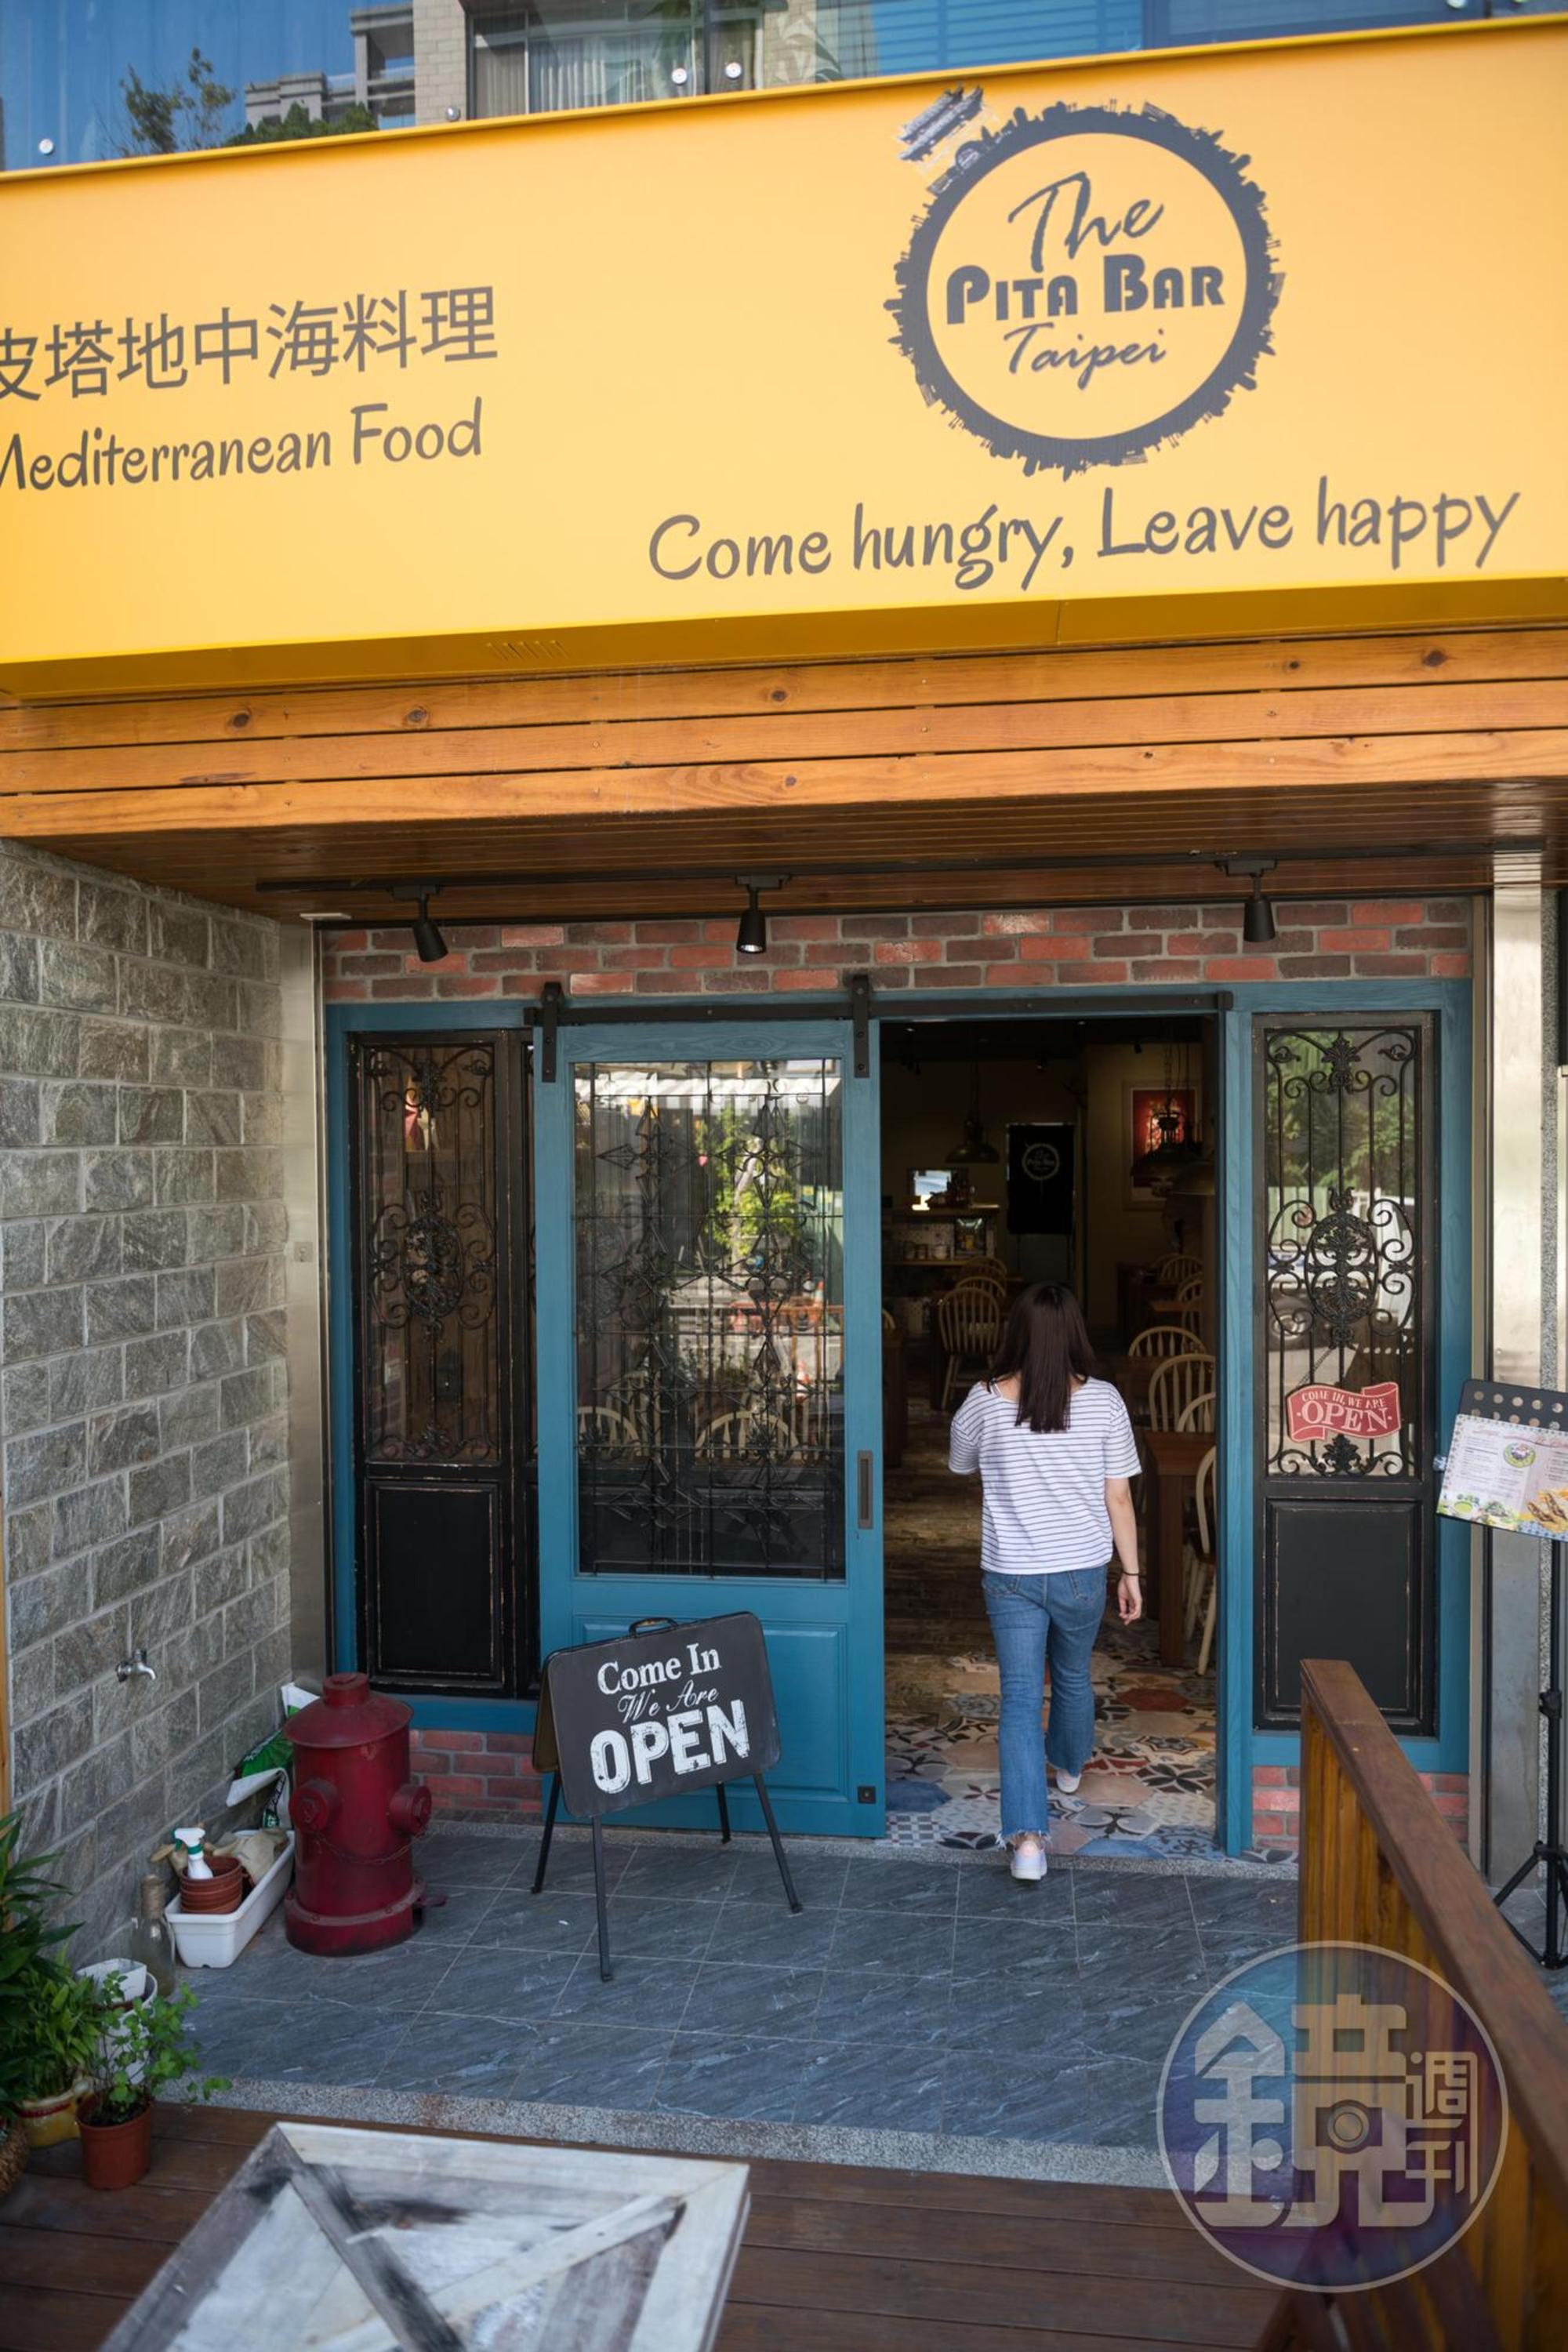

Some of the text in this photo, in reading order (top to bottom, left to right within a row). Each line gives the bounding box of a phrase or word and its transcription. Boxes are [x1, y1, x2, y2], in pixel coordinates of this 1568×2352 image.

[1007, 172, 1164, 274] The
[946, 253, 1225, 325] PITA BAR
[0, 285, 498, 401] 皮塔地中海料理
[1004, 321, 1167, 390] Taipei
[350, 396, 483, 465] Food
[649, 475, 1521, 591] Come hungry, Leave happy
[1301, 1390, 1330, 1402] COME
[1348, 1396, 1363, 1408] WE
[1365, 1397, 1385, 1409] ARE
[1301, 1399, 1388, 1432] OPEN
[597, 1642, 722, 1696] Come In
[617, 1679, 720, 1724] We Are
[590, 1699, 751, 1795] OPEN
